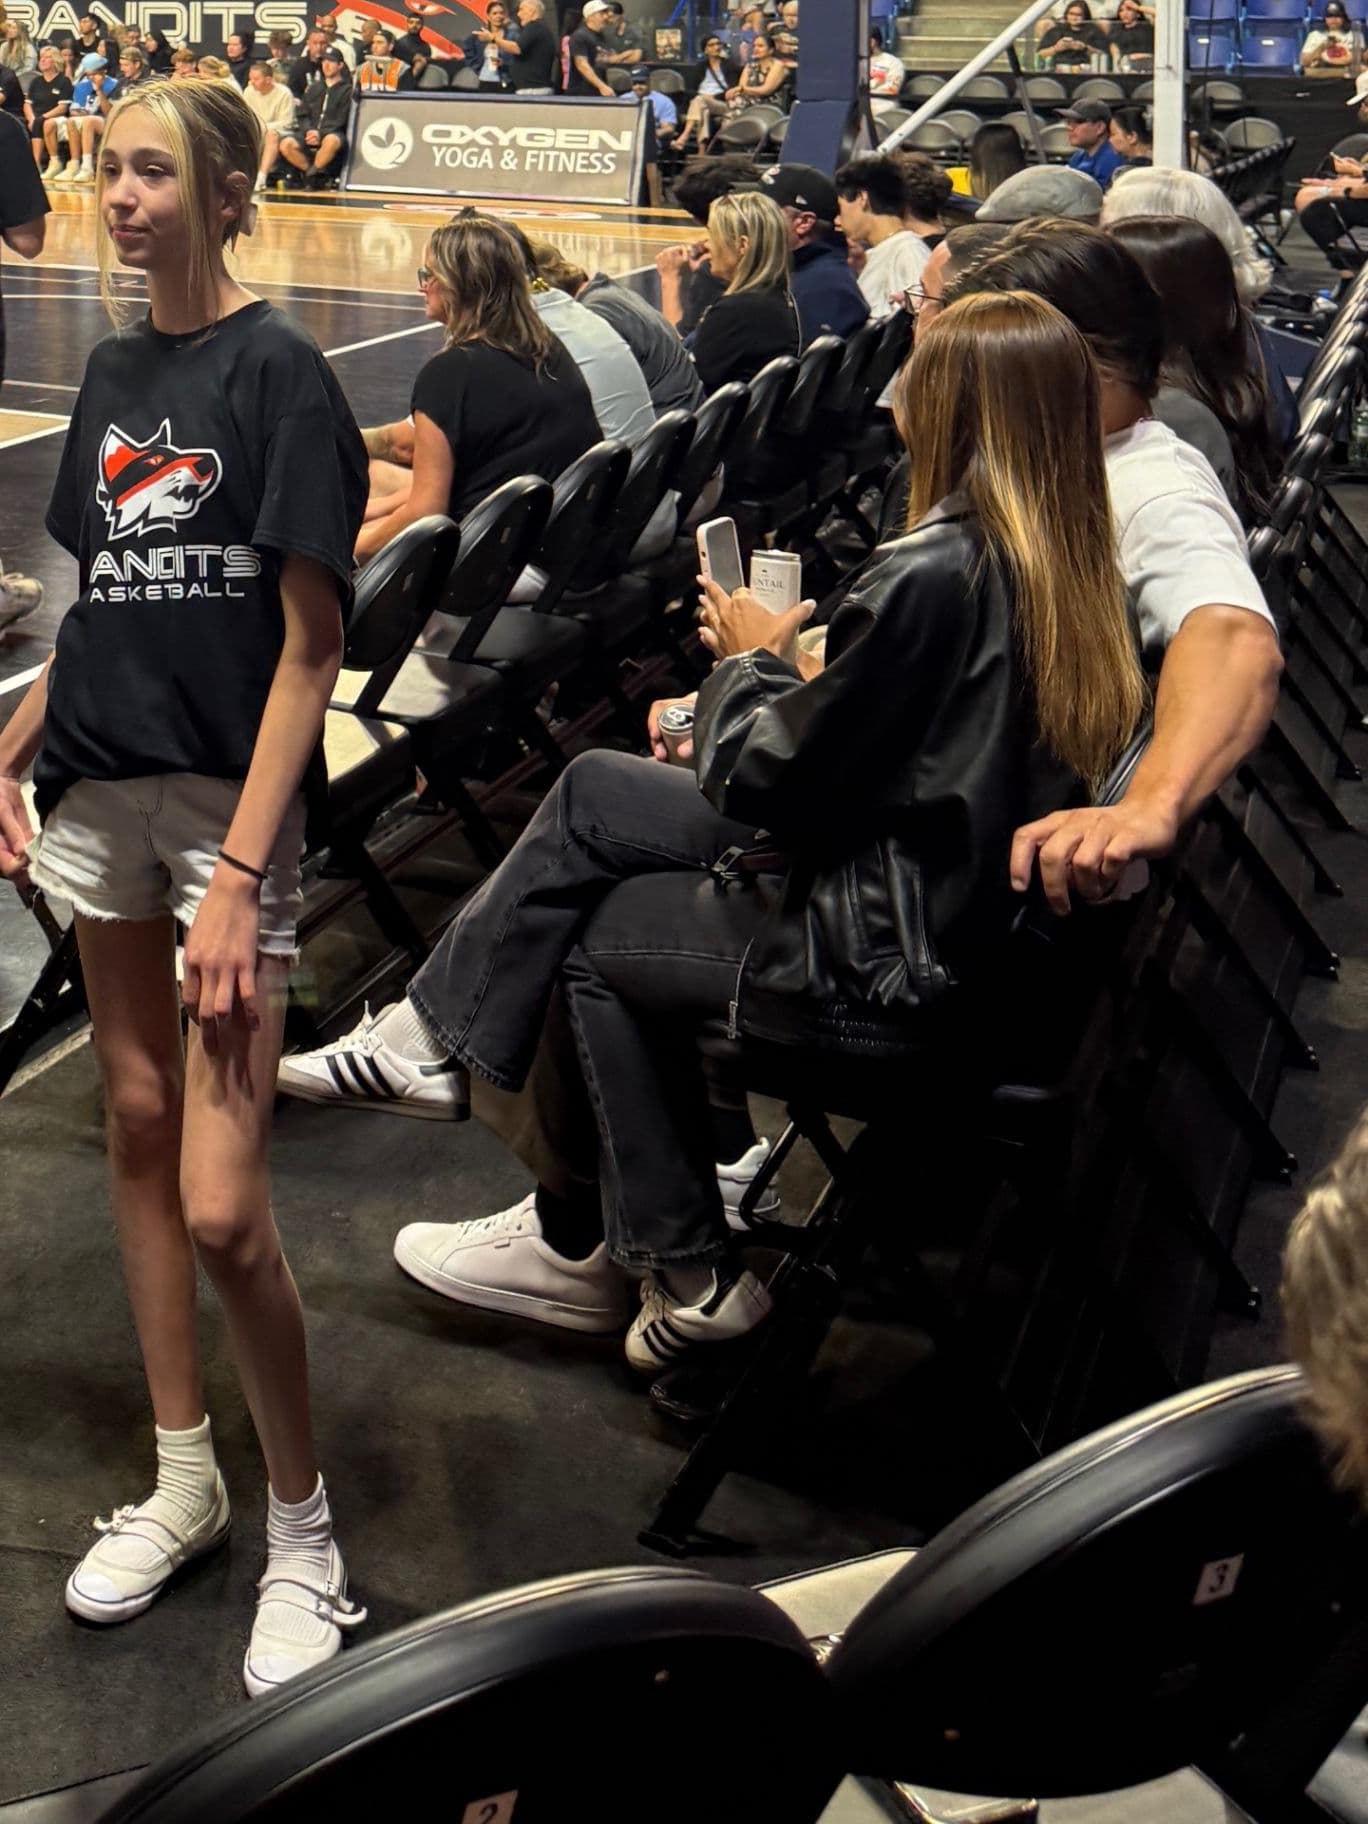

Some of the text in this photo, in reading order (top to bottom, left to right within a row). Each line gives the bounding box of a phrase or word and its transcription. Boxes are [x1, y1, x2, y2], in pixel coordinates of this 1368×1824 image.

[422, 124, 632, 151] OXYGEN
[432, 146, 616, 174] YOGA & FITNESS
[1209, 1563, 1229, 1593] 3
